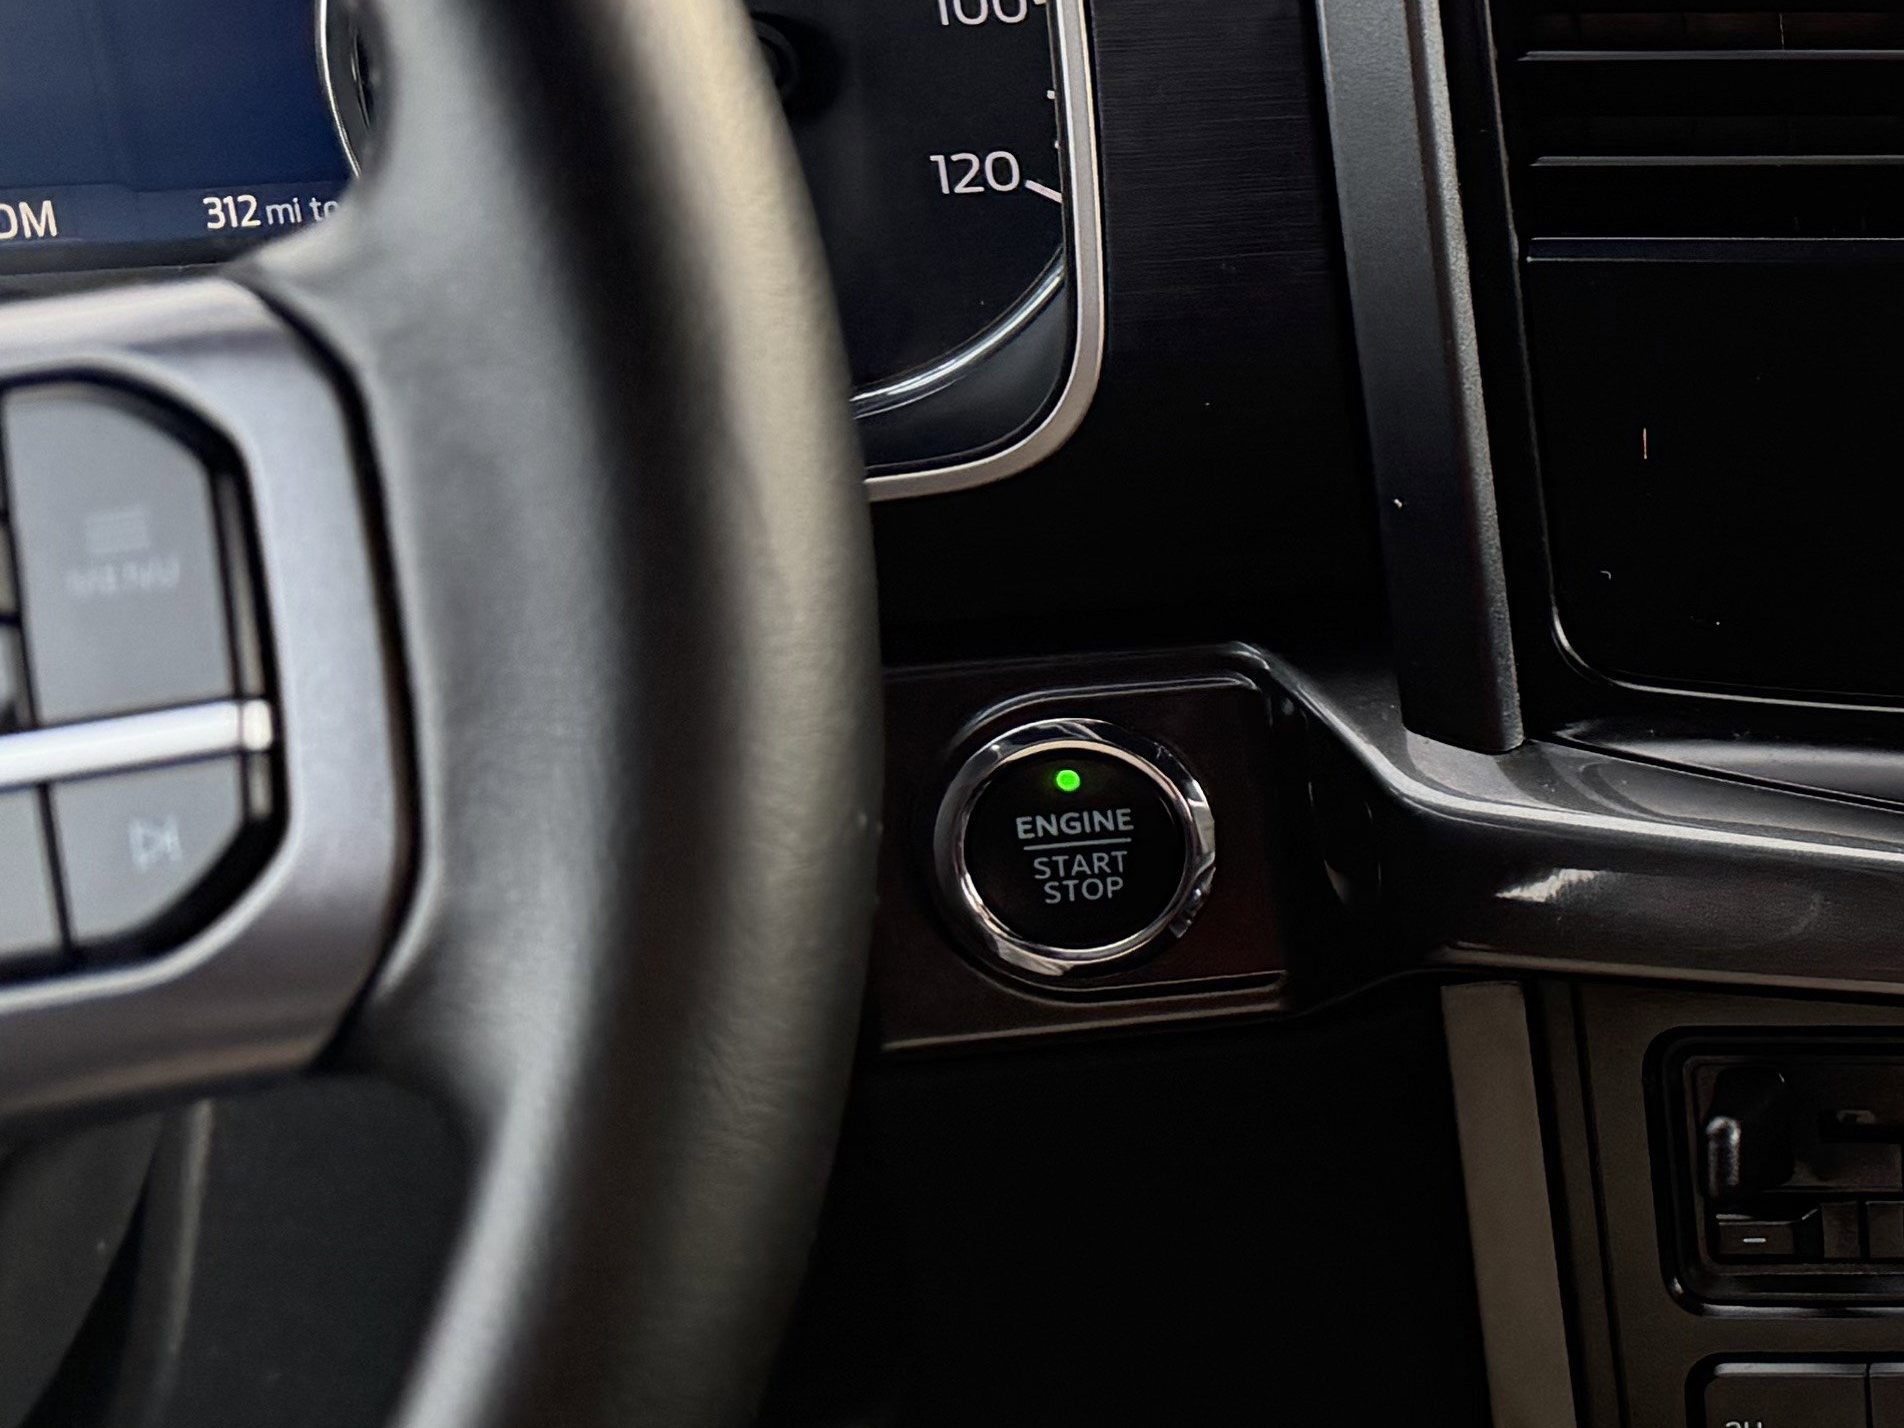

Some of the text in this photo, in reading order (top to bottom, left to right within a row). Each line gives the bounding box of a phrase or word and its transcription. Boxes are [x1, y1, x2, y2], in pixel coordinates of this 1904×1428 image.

[929, 150, 1021, 195] 120
[202, 194, 262, 230] 312
[265, 196, 302, 225] mi
[1015, 808, 1135, 840] ENGINE
[1033, 850, 1128, 880] START
[1044, 876, 1124, 904] STOP
